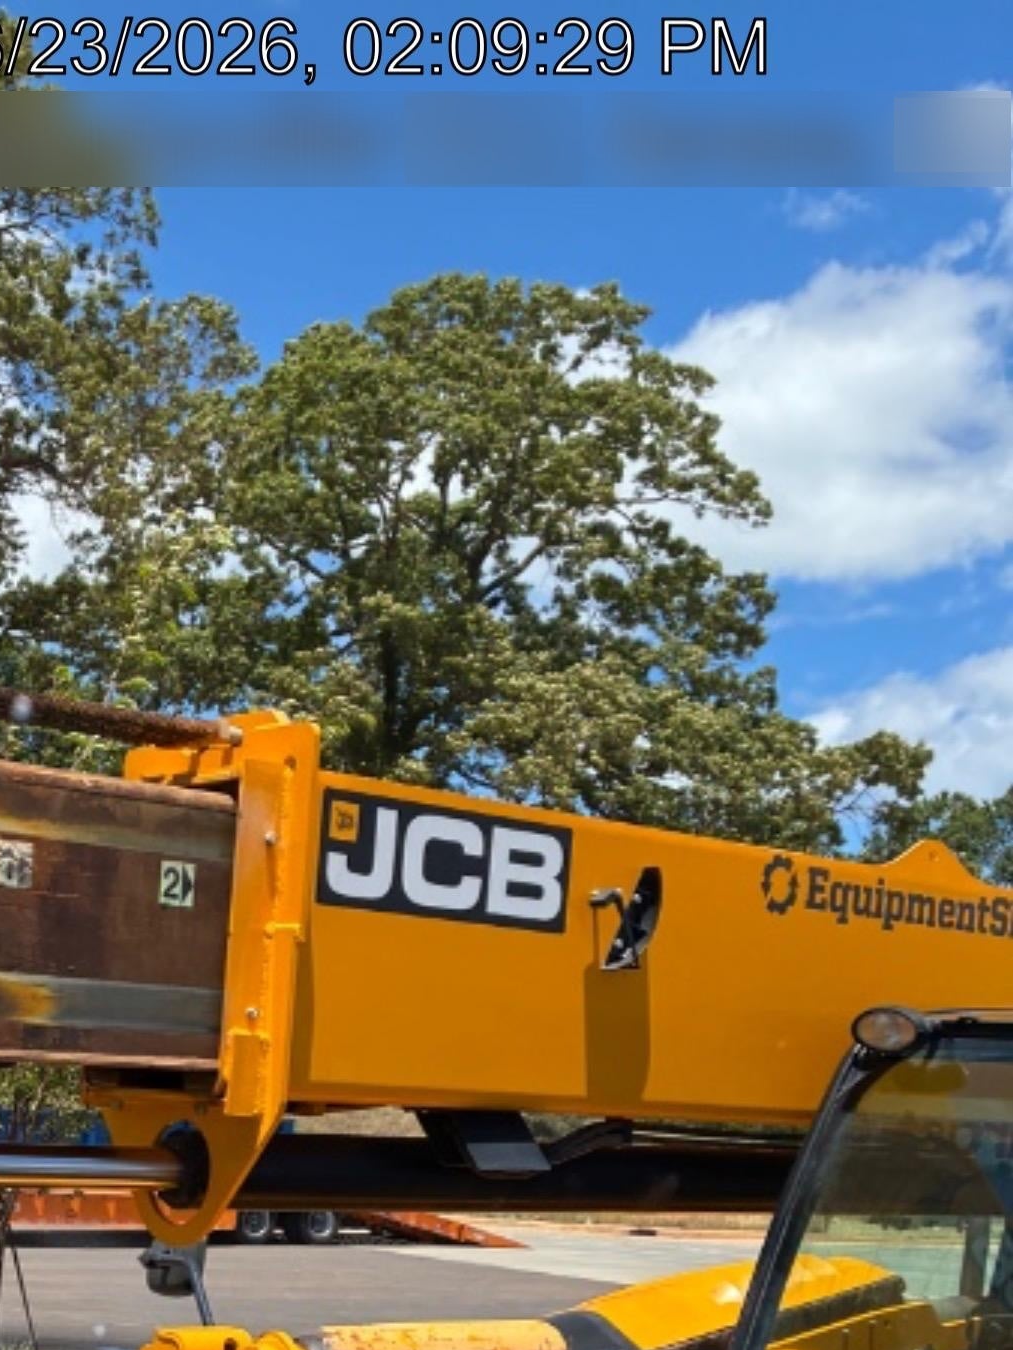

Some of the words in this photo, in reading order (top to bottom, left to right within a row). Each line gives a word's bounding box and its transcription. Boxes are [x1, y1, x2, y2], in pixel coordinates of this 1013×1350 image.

[162, 866, 180, 899] 2
[325, 806, 564, 921] JCB
[804, 865, 1013, 939] EquipmentS
